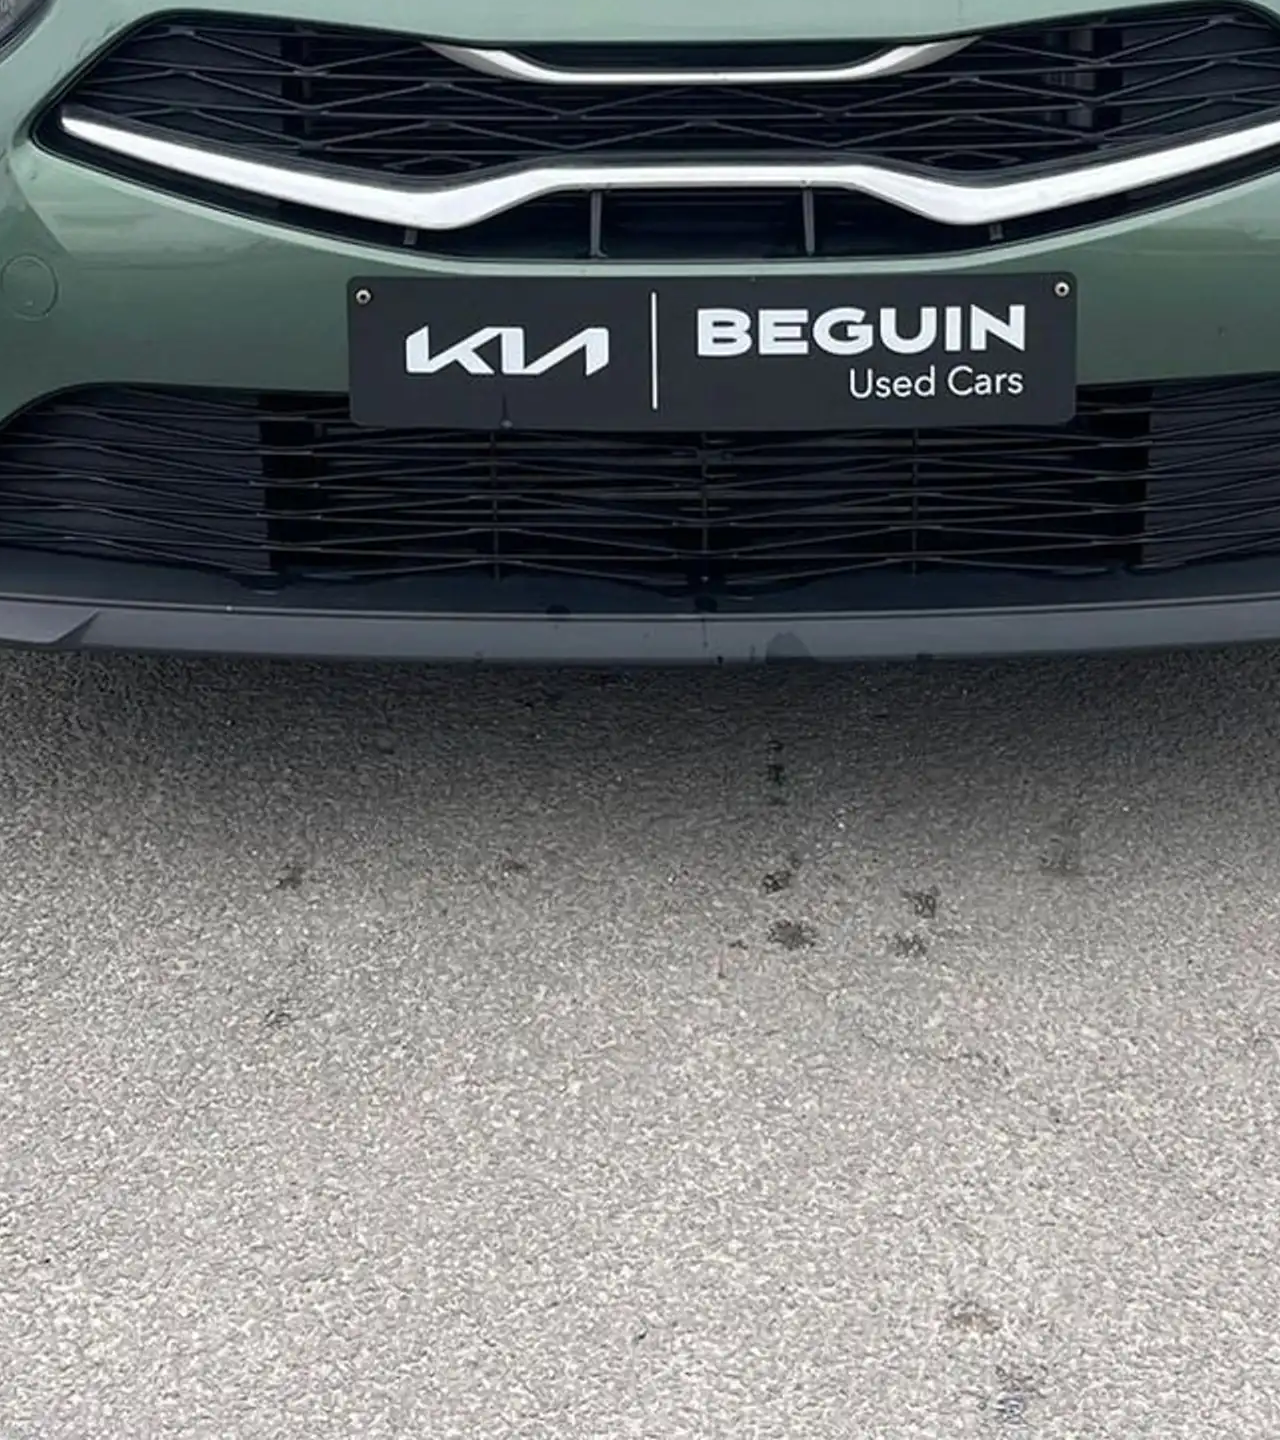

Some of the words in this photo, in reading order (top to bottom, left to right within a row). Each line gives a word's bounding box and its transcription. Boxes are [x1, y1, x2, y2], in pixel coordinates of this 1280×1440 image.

[405, 326, 609, 376] KIA
[697, 303, 1026, 358] BEGUIN
[849, 366, 936, 400] Used
[948, 365, 1024, 397] Cars
